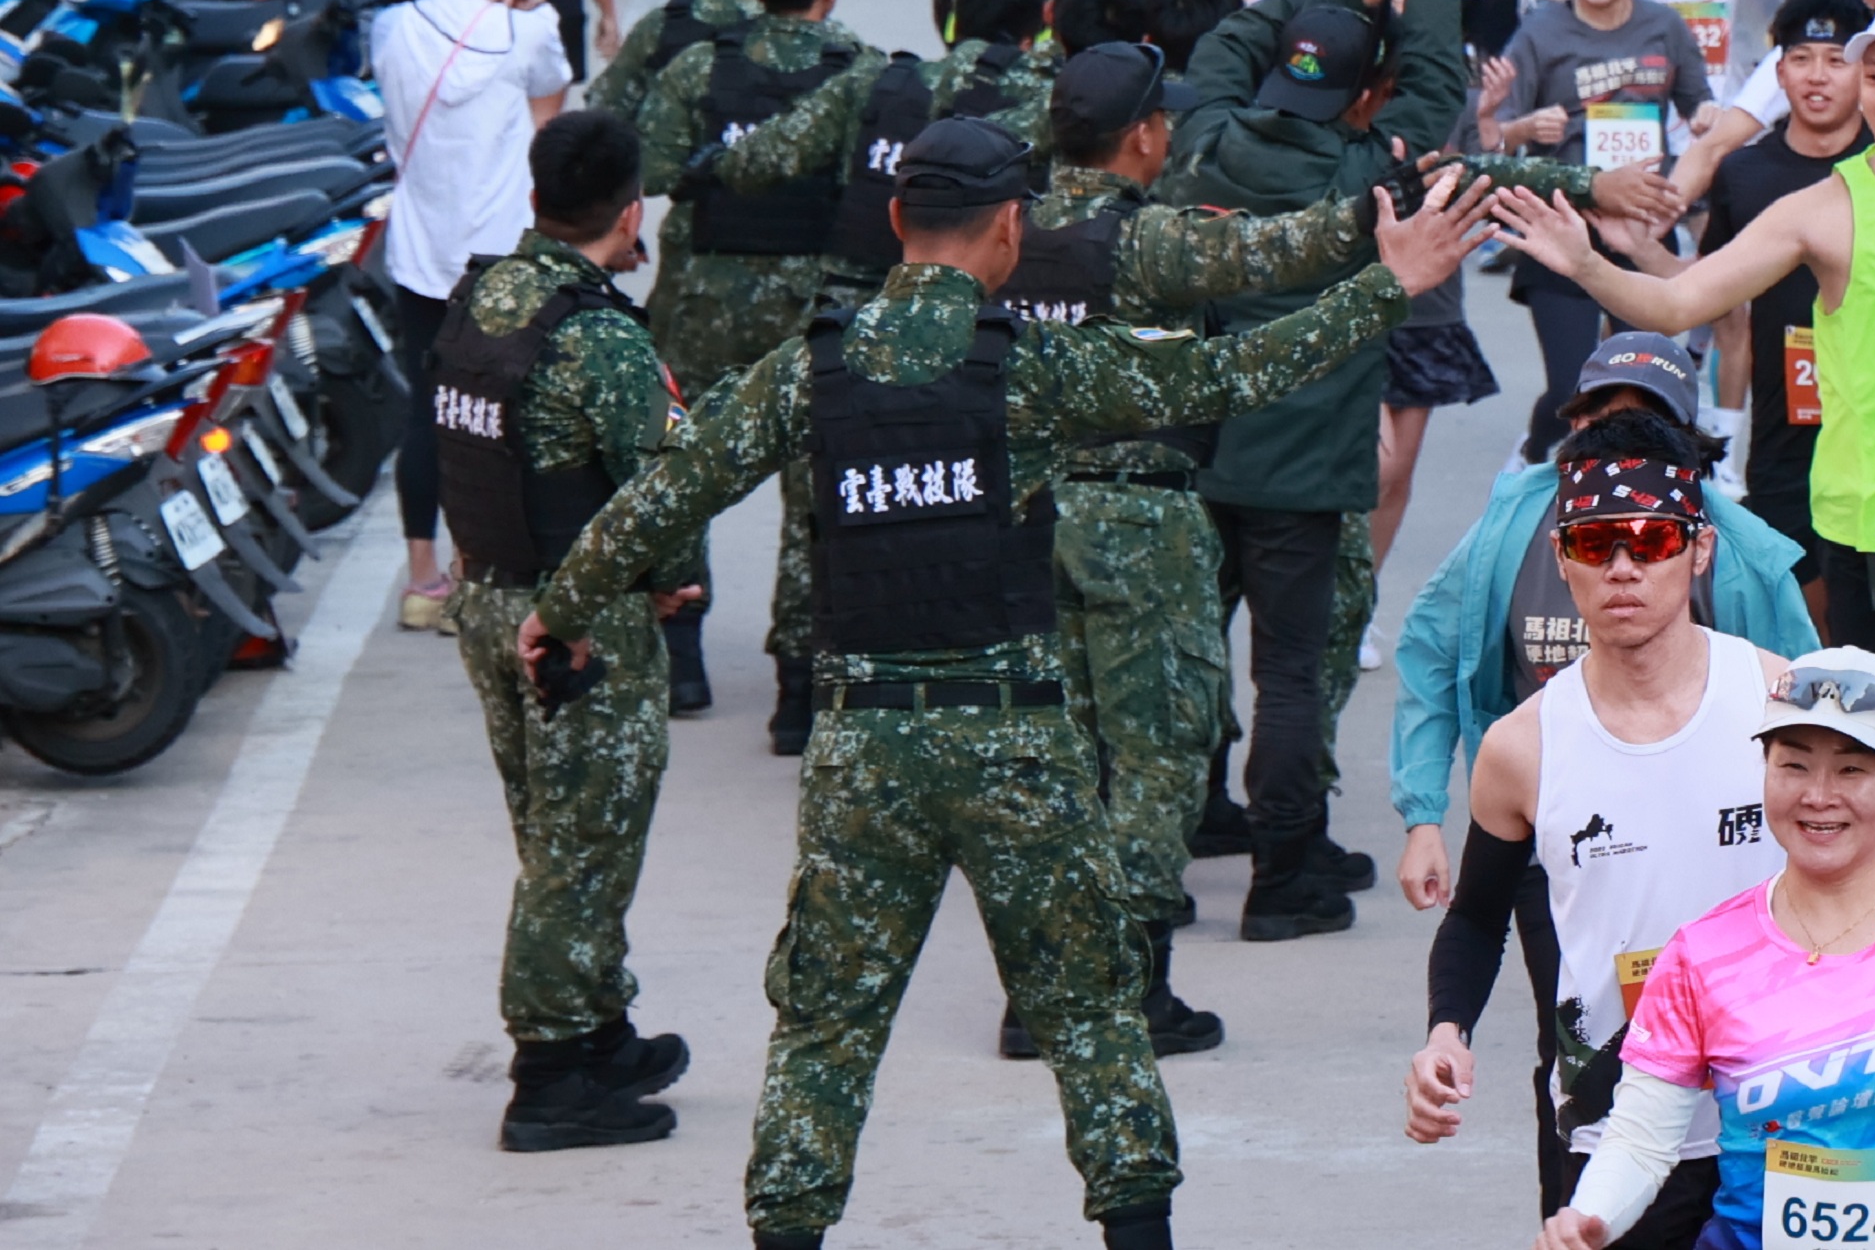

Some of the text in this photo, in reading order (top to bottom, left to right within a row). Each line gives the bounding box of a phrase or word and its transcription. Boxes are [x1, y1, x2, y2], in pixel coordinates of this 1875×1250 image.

[1597, 132, 1651, 152] 2536
[838, 458, 984, 515] 雲臺戰技隊
